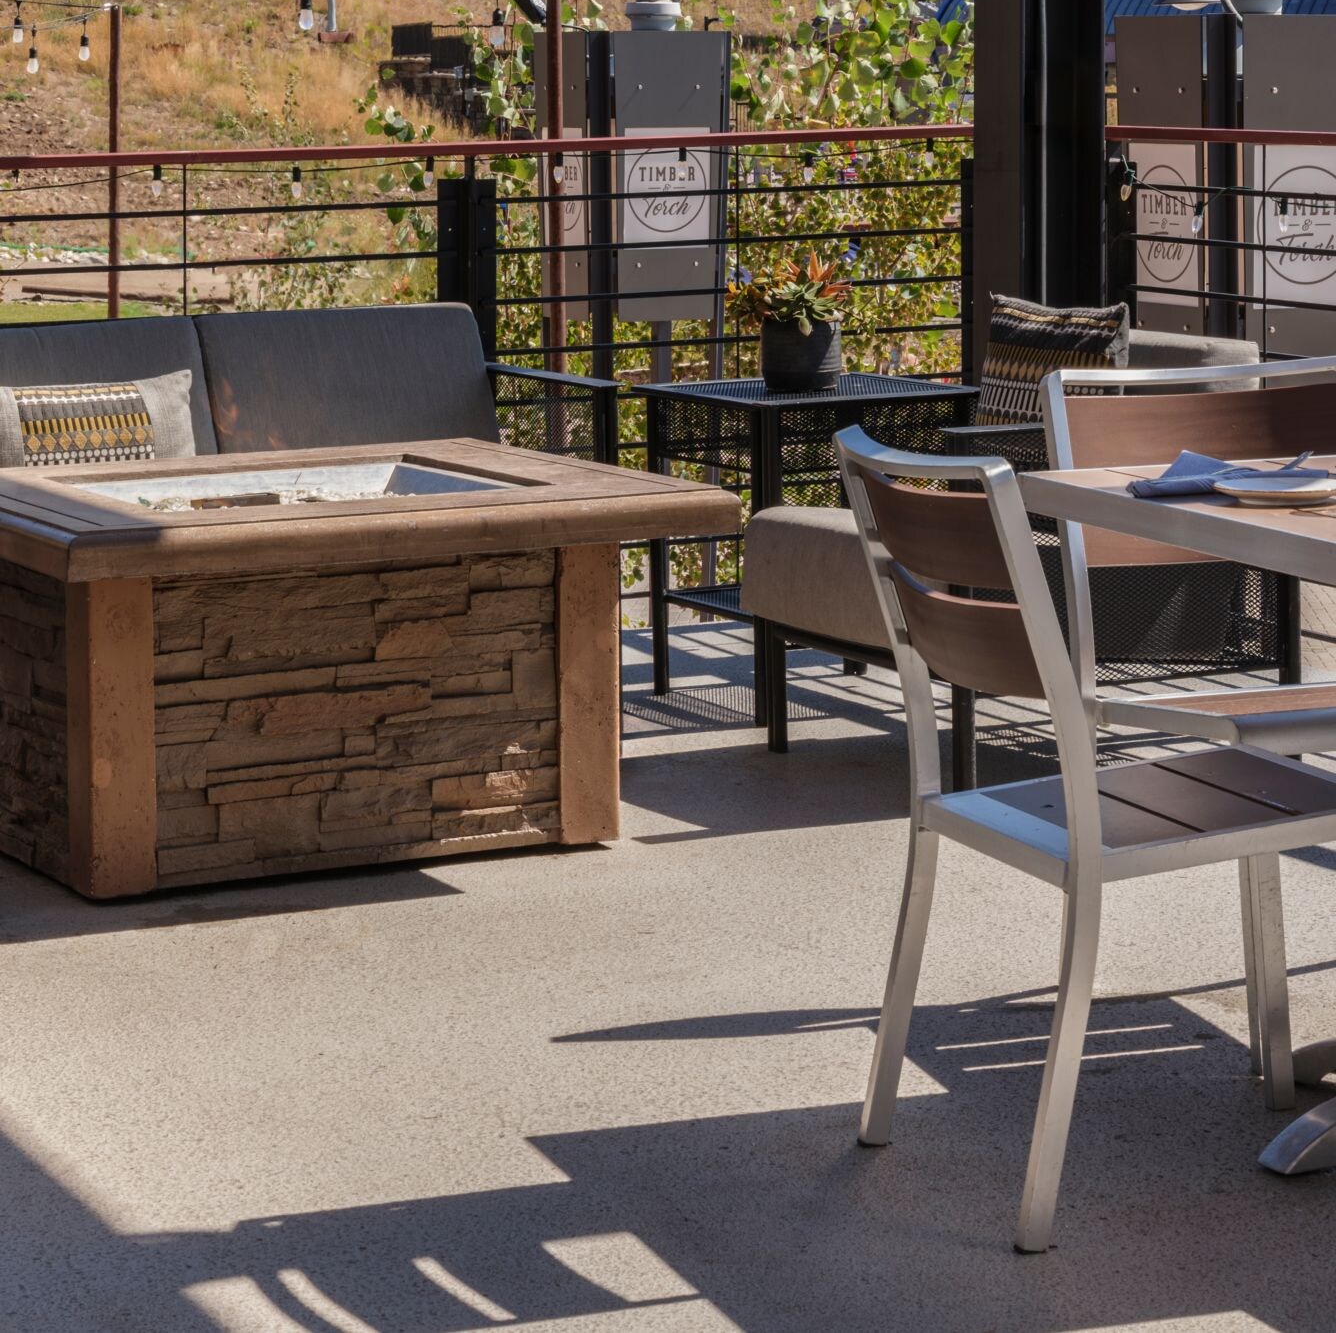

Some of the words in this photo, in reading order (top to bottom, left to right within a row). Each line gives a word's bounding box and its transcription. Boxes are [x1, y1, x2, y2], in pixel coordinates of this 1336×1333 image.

[639, 166, 696, 182] TIMBR
[642, 195, 691, 218] Torch
[1141, 194, 1188, 216] TIMBER
[1160, 218, 1168, 228] &
[1302, 218, 1313, 231] &
[1148, 231, 1184, 262] Torch
